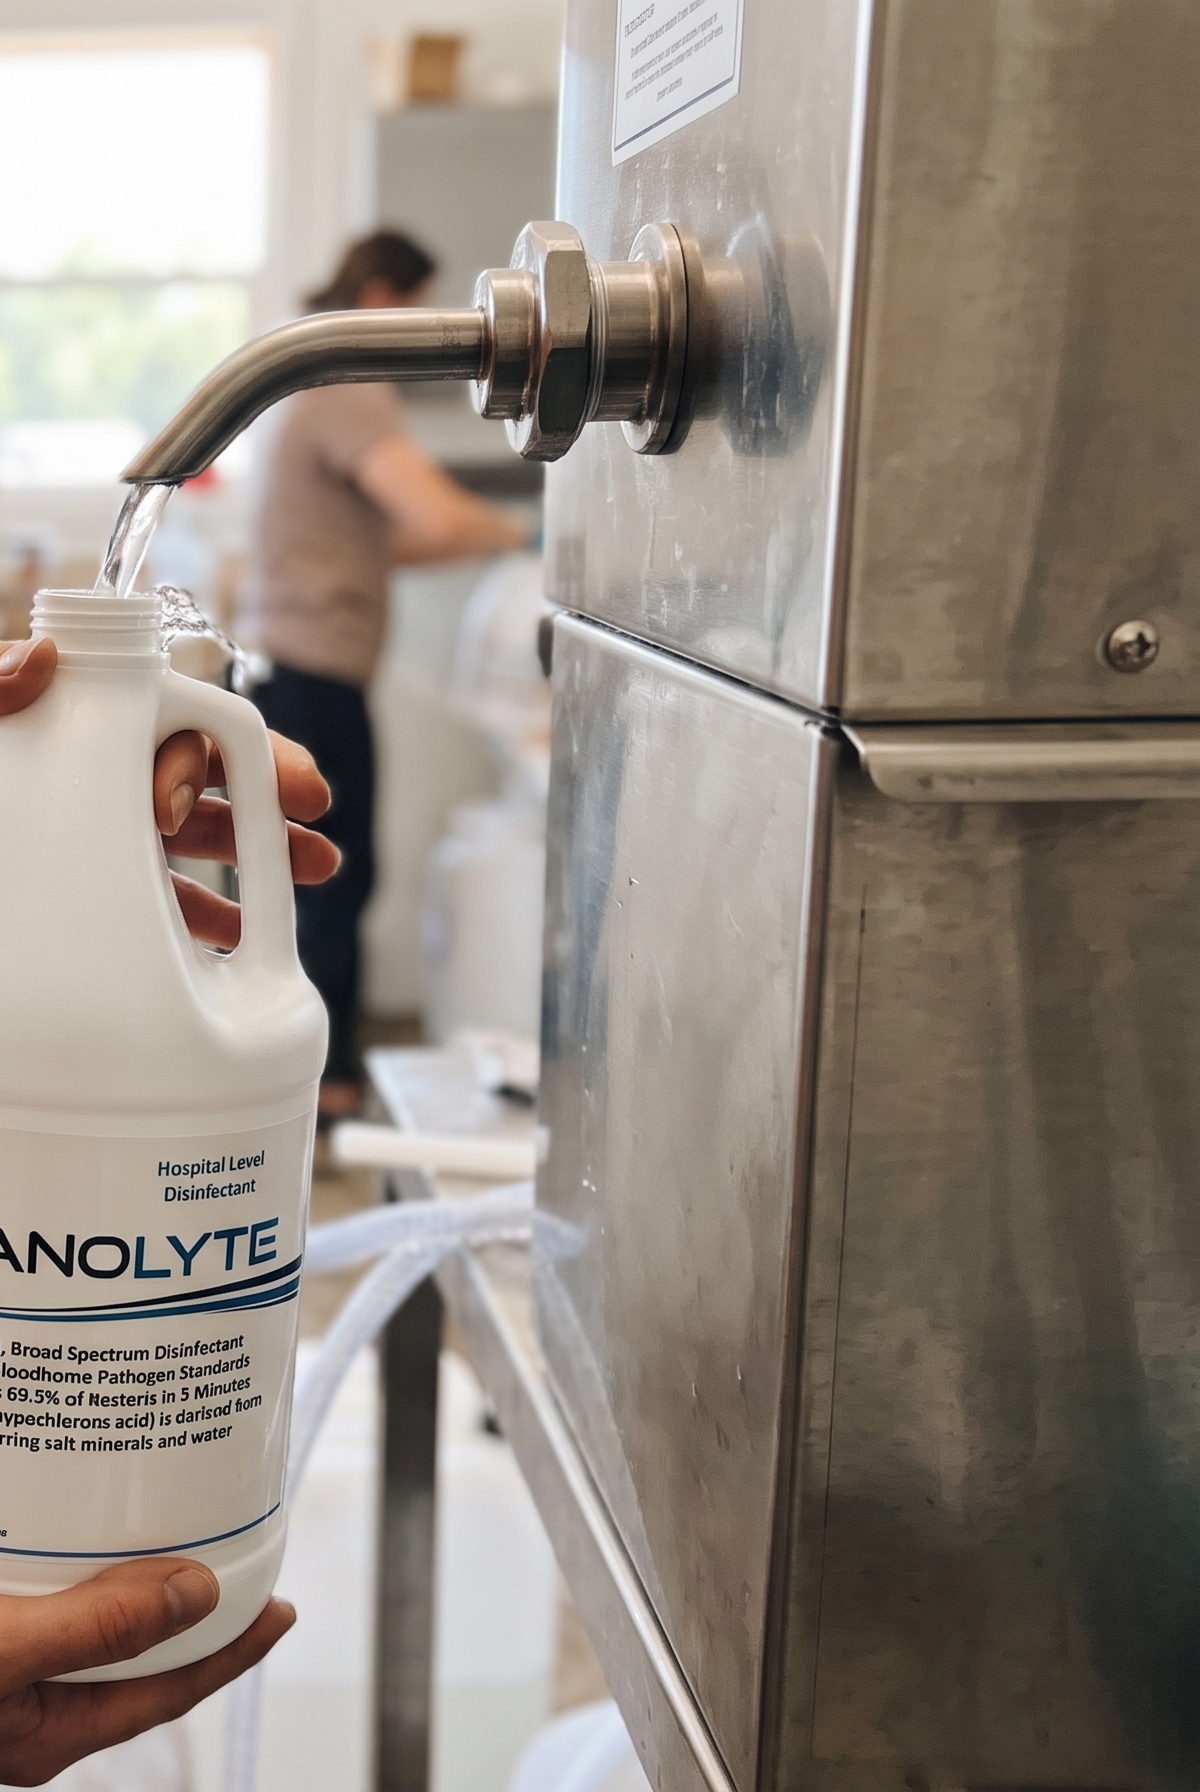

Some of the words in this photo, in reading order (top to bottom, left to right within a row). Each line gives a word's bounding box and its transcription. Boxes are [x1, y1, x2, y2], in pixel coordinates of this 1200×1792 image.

[158, 1156, 225, 1179] Hospital
[229, 1150, 265, 1171] Level
[164, 1179, 256, 1202] Disinfectant
[11, 1341, 63, 1360] Broad
[67, 1346, 150, 1365] Spectrum
[154, 1335, 244, 1360] Disinfectant
[98, 1369, 175, 1386] Pathogen
[179, 1354, 250, 1380] Standards
[7, 1387, 59, 1405] 69.5%
[65, 1391, 85, 1406] of
[162, 1390, 176, 1404] in
[180, 1387, 190, 1402] 5
[194, 1377, 251, 1400] Minutes
[115, 1412, 155, 1430] acid)
[159, 1412, 172, 1426] is
[44, 1436, 76, 1451] salt
[81, 1435, 153, 1451] minerals
[158, 1431, 187, 1448] and
[191, 1425, 233, 1445] water
